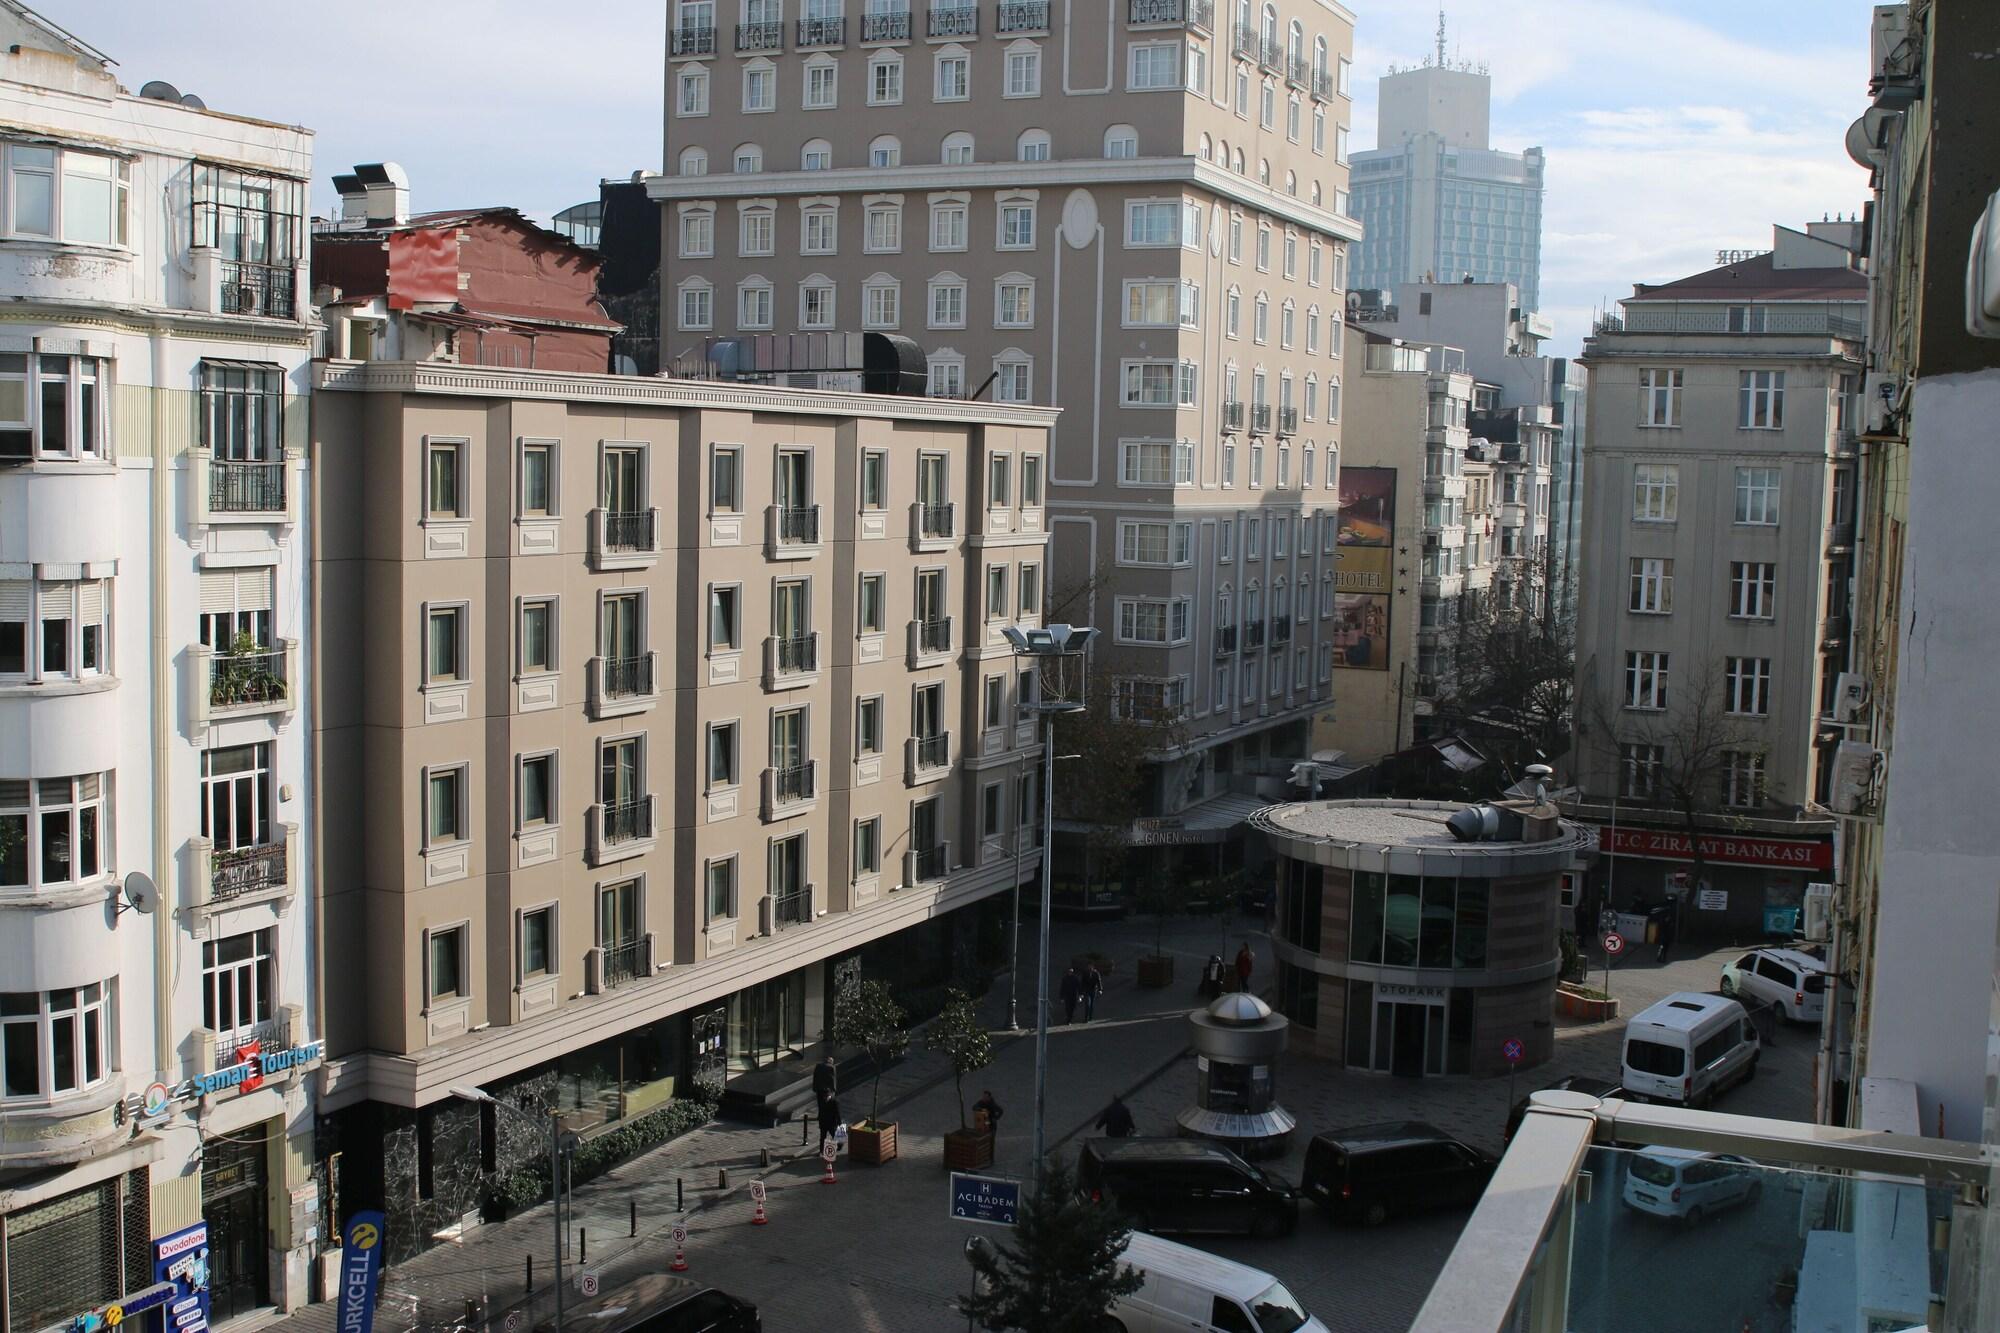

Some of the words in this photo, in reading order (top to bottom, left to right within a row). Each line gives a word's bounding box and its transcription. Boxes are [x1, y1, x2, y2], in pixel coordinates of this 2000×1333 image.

[1336, 571, 1384, 588] HOTEL
[1615, 832, 1645, 848] T.C.
[1649, 834, 1720, 854] ZİRAAT
[1725, 842, 1812, 862] BANKASI
[194, 1065, 250, 1097] Seman
[259, 1044, 320, 1075] Tourism
[958, 1192, 1014, 1207] ACIBADEM
[169, 1233, 205, 1253] vodafone
[345, 1250, 370, 1333] URKCELL
